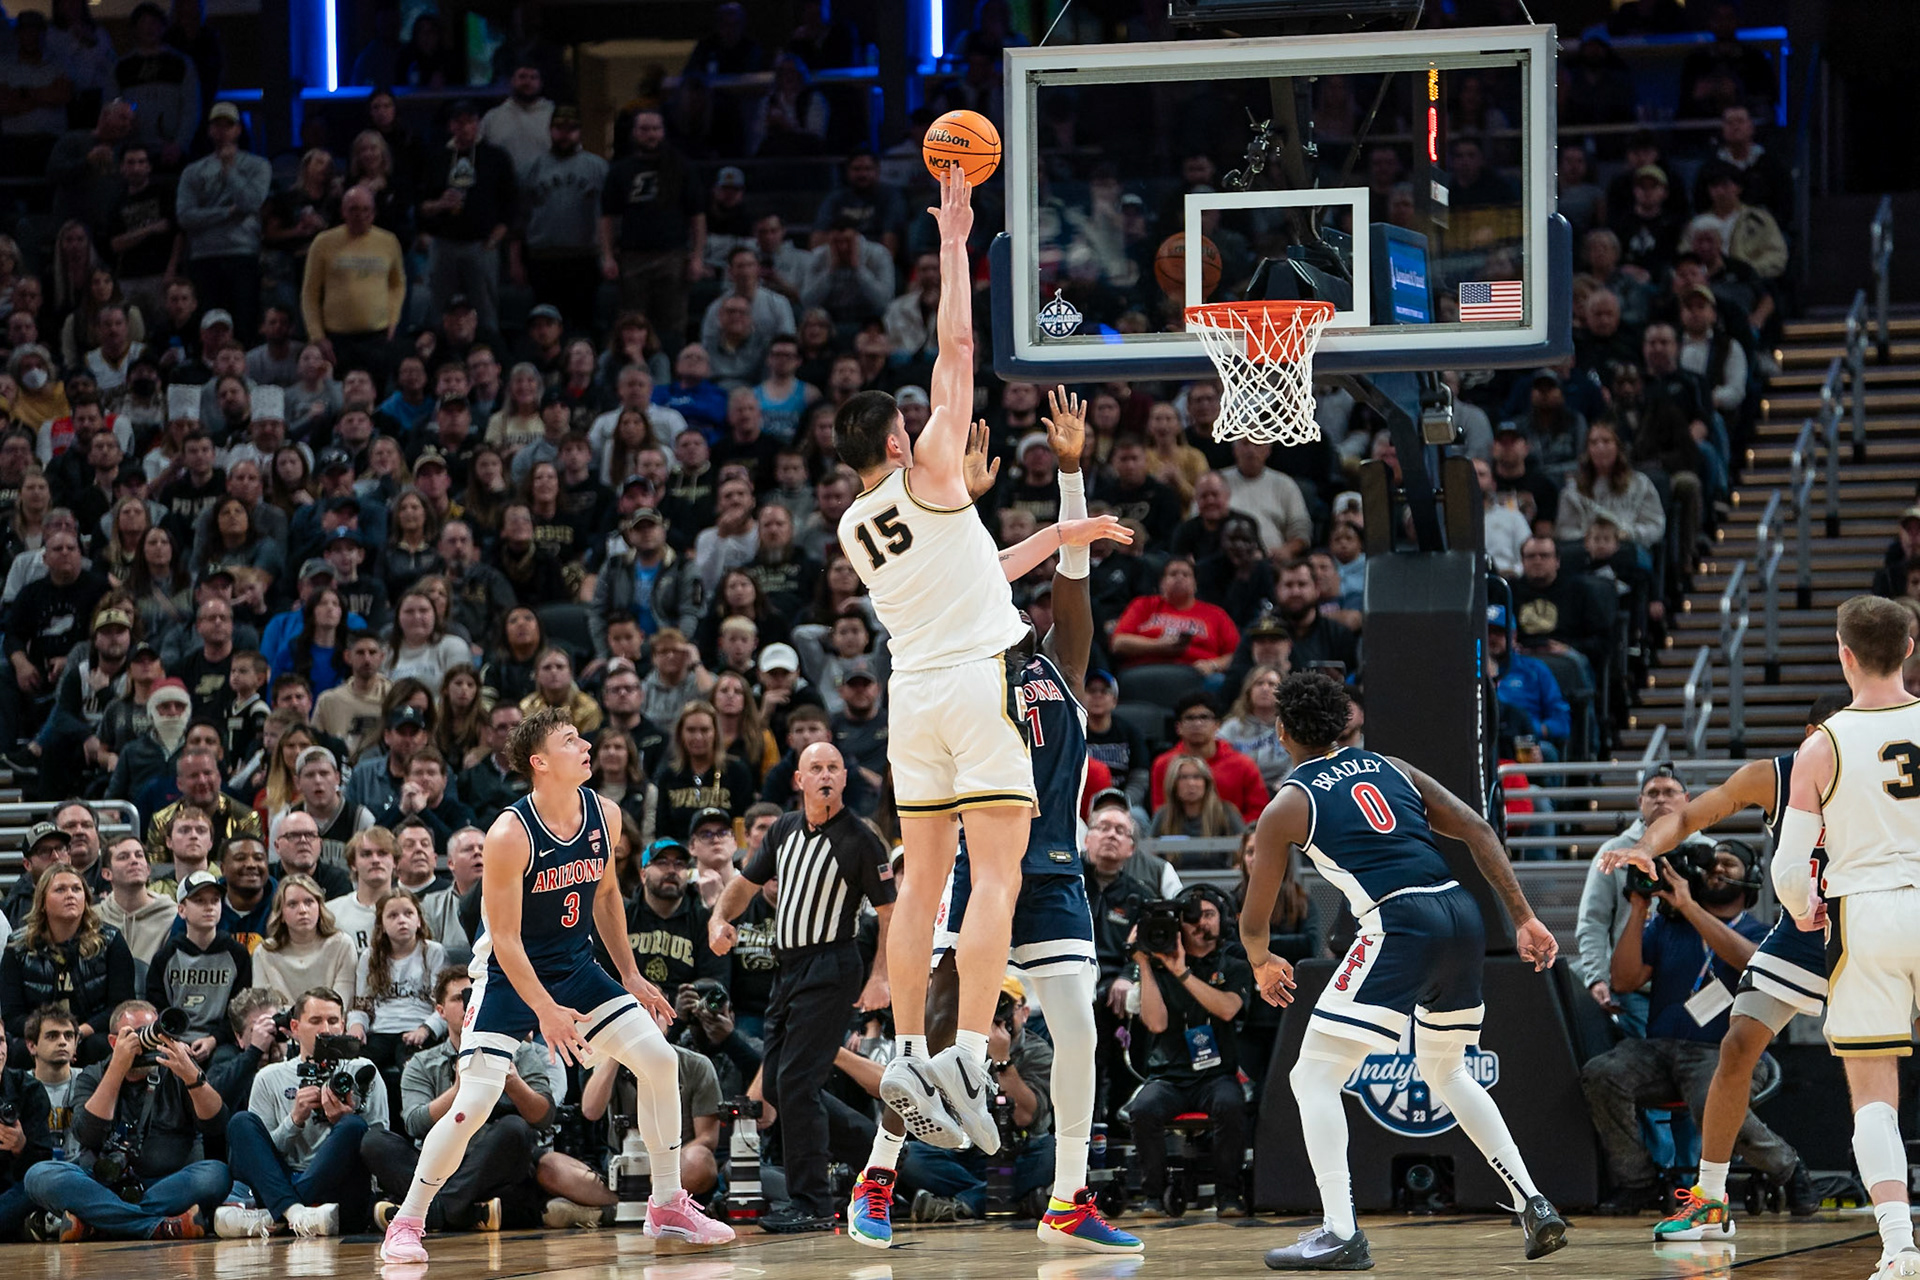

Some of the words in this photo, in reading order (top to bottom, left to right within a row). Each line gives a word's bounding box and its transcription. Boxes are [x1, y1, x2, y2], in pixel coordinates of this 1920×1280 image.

[927, 129, 971, 149] Wilson
[929, 155, 960, 170] NCAA
[854, 507, 914, 571] 15
[1023, 679, 1066, 703] ONA
[1311, 758, 1382, 792] BRADLEY
[1878, 739, 1920, 800] 3
[1350, 781, 1397, 834] 0
[531, 857, 605, 894] ARIZONA
[560, 891, 582, 928] 3
[628, 930, 695, 968] PURDUE
[170, 968, 229, 988] PURDUE
[1345, 1055, 1417, 1092] Indy
[1413, 1109, 1427, 1123] 23
